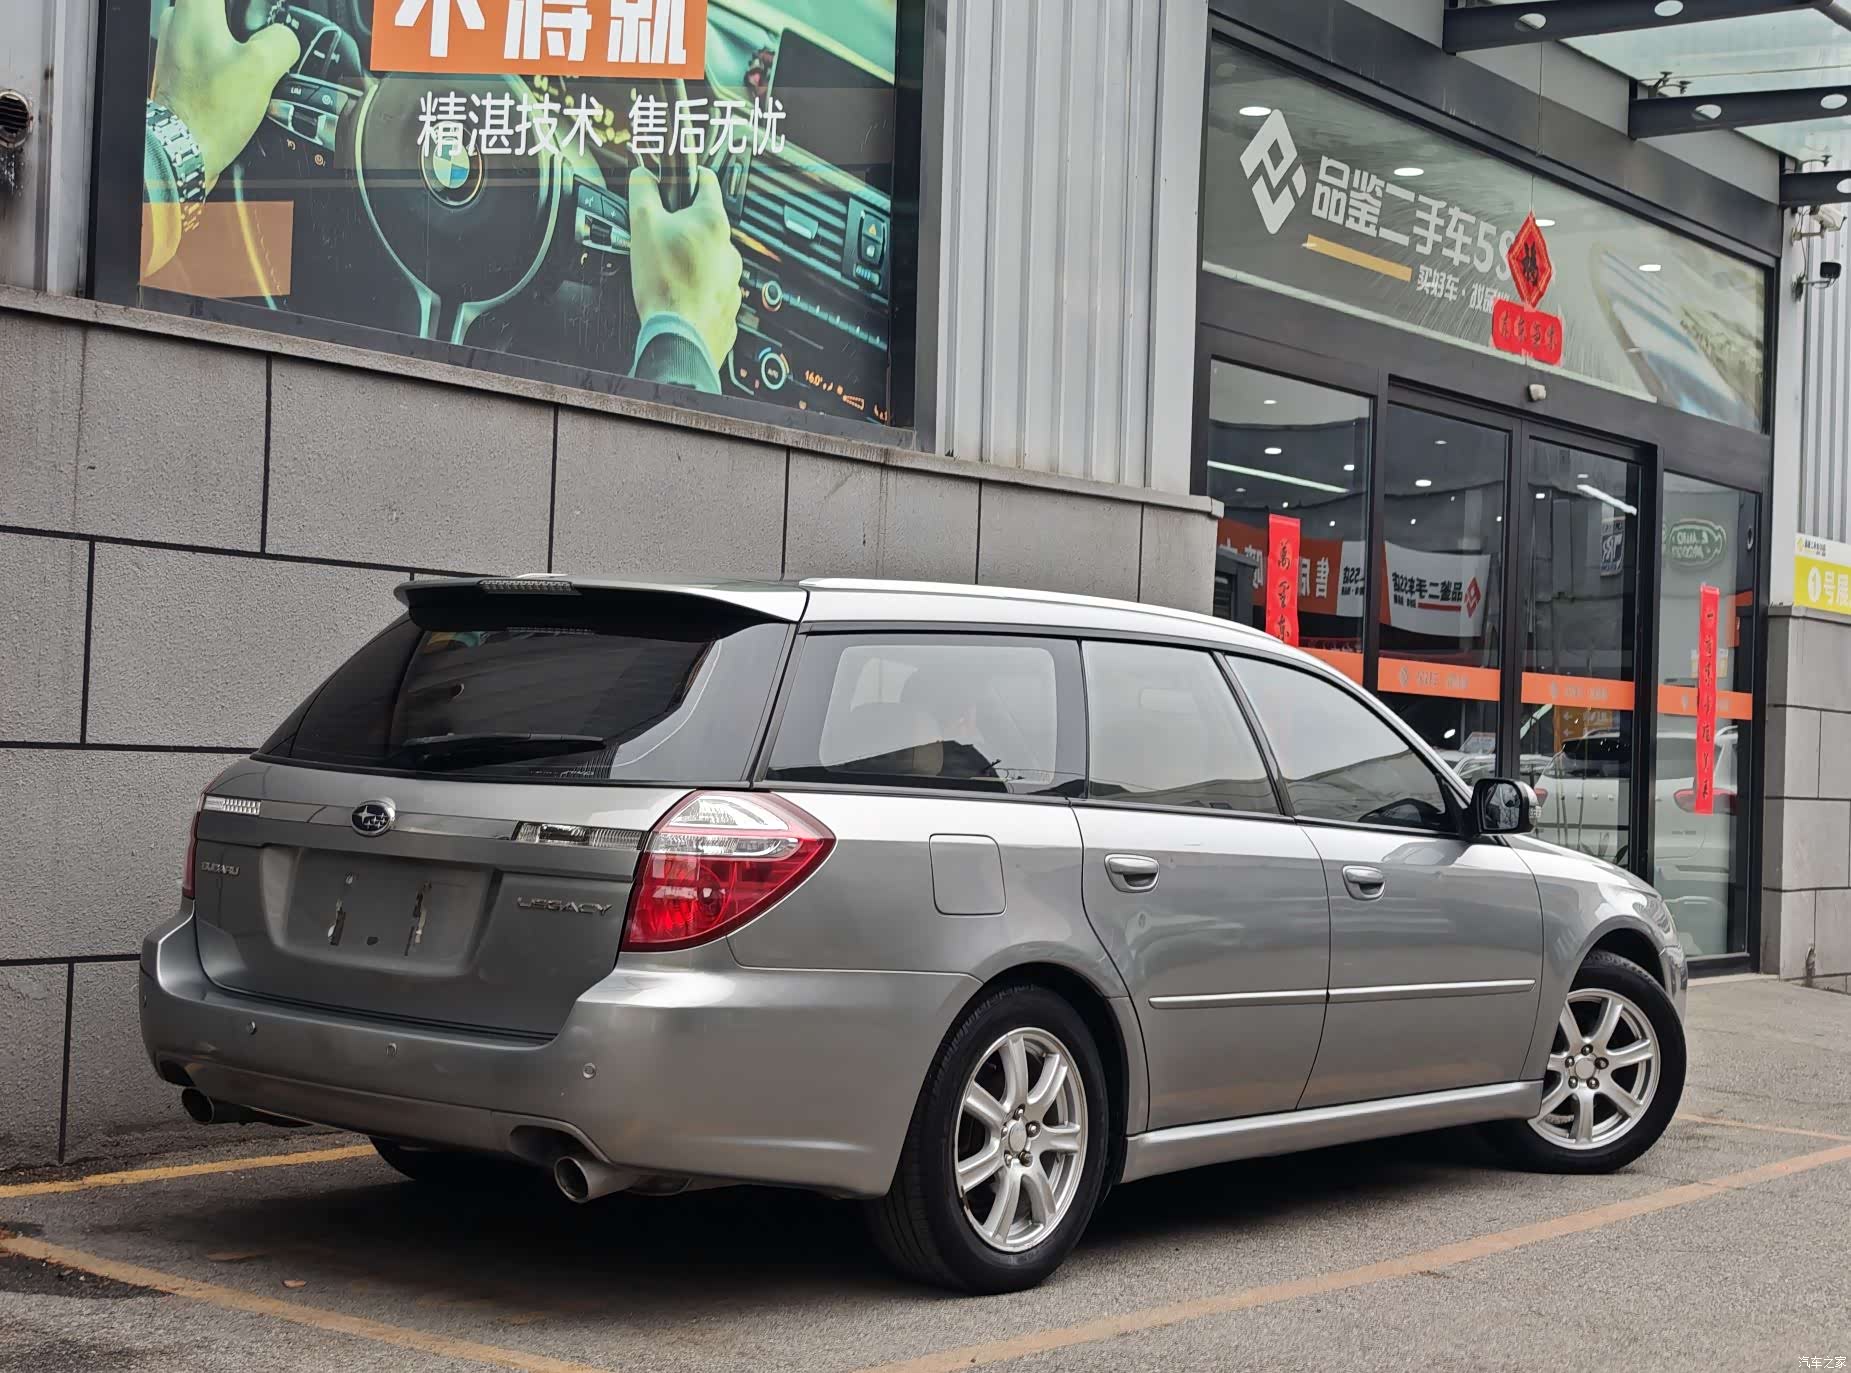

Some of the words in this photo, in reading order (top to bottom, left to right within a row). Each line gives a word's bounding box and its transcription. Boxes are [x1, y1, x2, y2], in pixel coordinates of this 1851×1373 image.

[417, 91, 603, 156] 精湛技术
[628, 94, 786, 156] 售后无忧
[1311, 155, 1516, 281] 品鉴二手车5S
[201, 861, 241, 876] SUBARU
[517, 896, 612, 917] LEGACY
